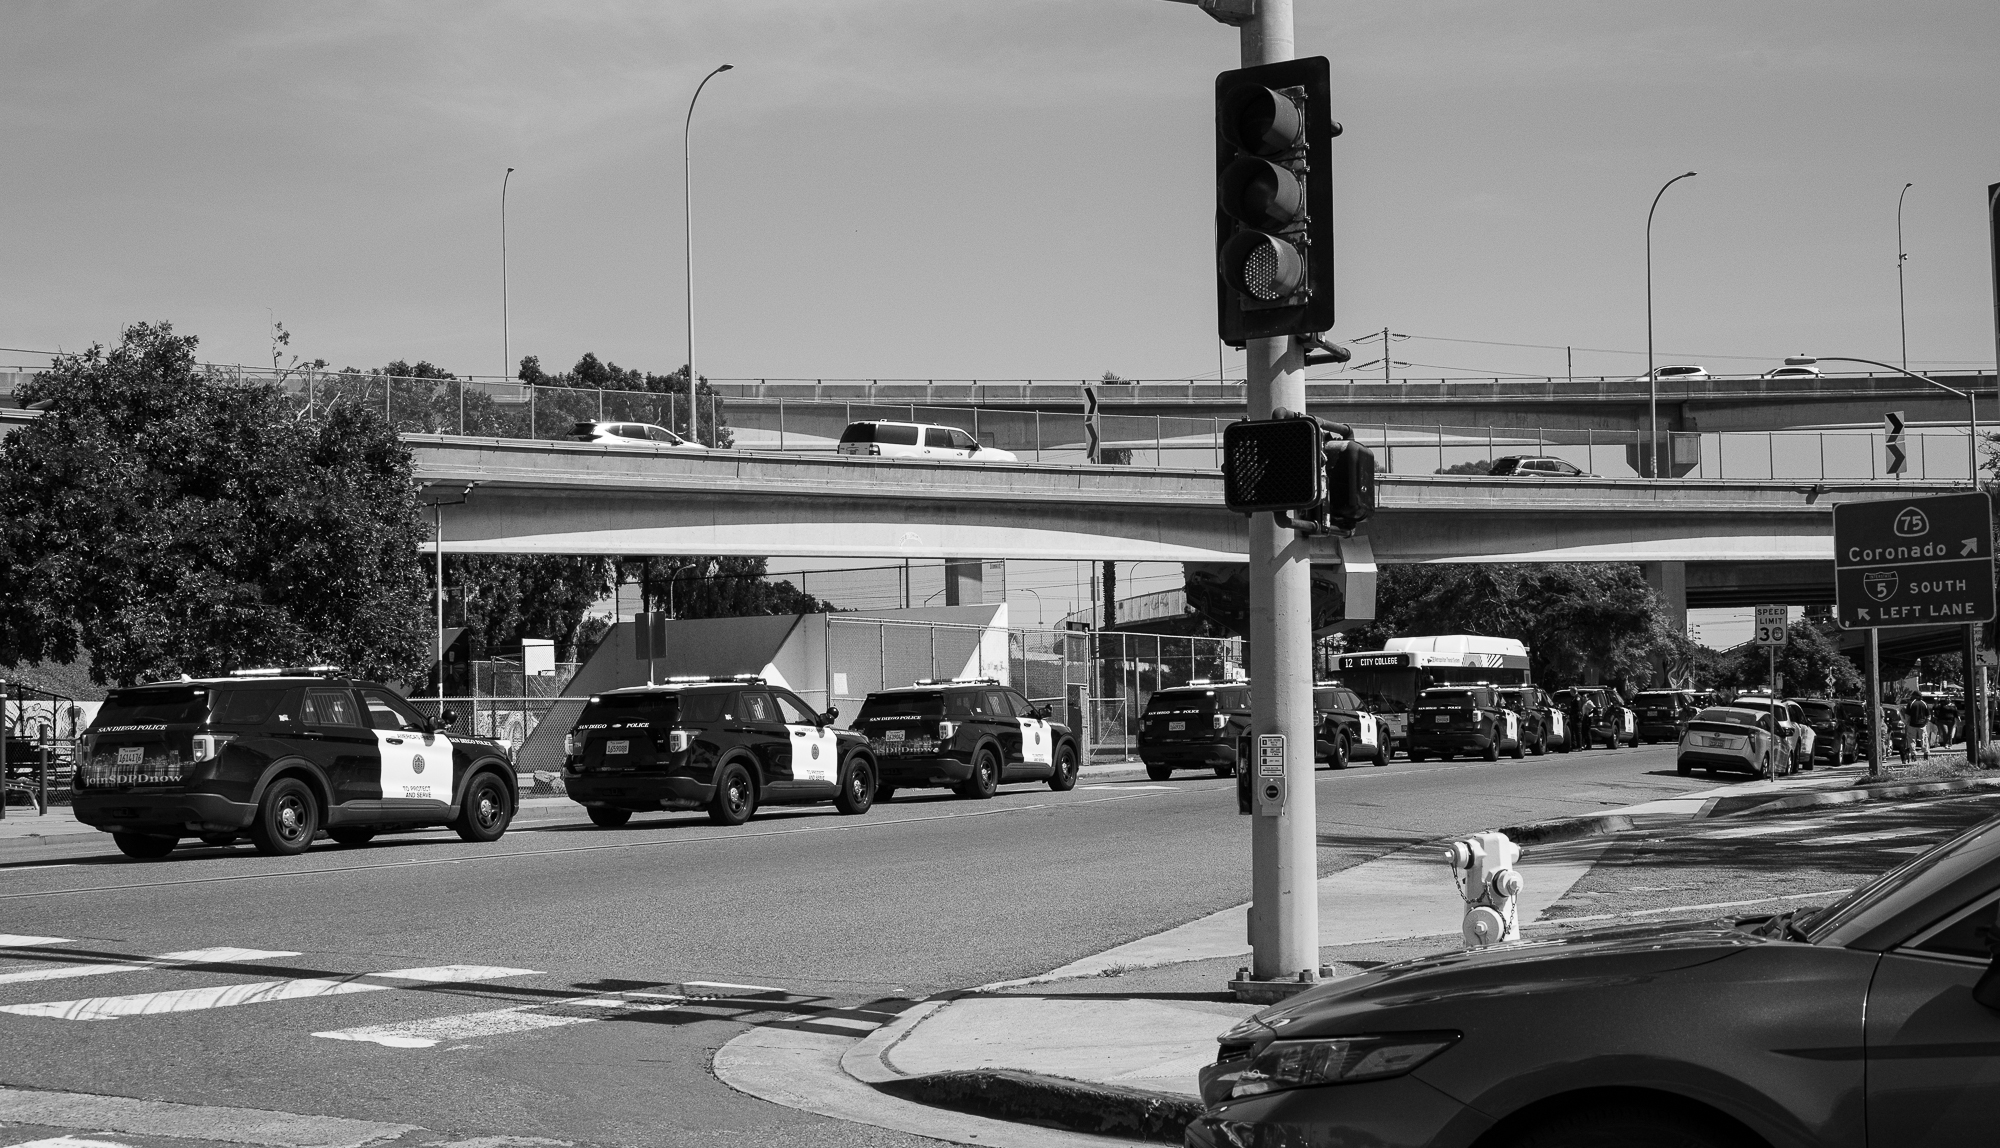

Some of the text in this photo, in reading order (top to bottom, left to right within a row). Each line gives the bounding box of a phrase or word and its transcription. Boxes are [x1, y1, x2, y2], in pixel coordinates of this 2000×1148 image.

[1901, 515, 1923, 531] 75
[1849, 542, 1946, 562] Coronado
[1877, 579, 1966, 598] 5 SOUTH
[1757, 608, 1786, 616] SPEED
[1880, 602, 1975, 619] LEFT LANE
[1759, 617, 1783, 625] LIMIT
[1759, 626, 1784, 642] 30
[1345, 656, 1398, 668] 12 CITY COLLEGE
[86, 773, 183, 787] joinSDPDnow
